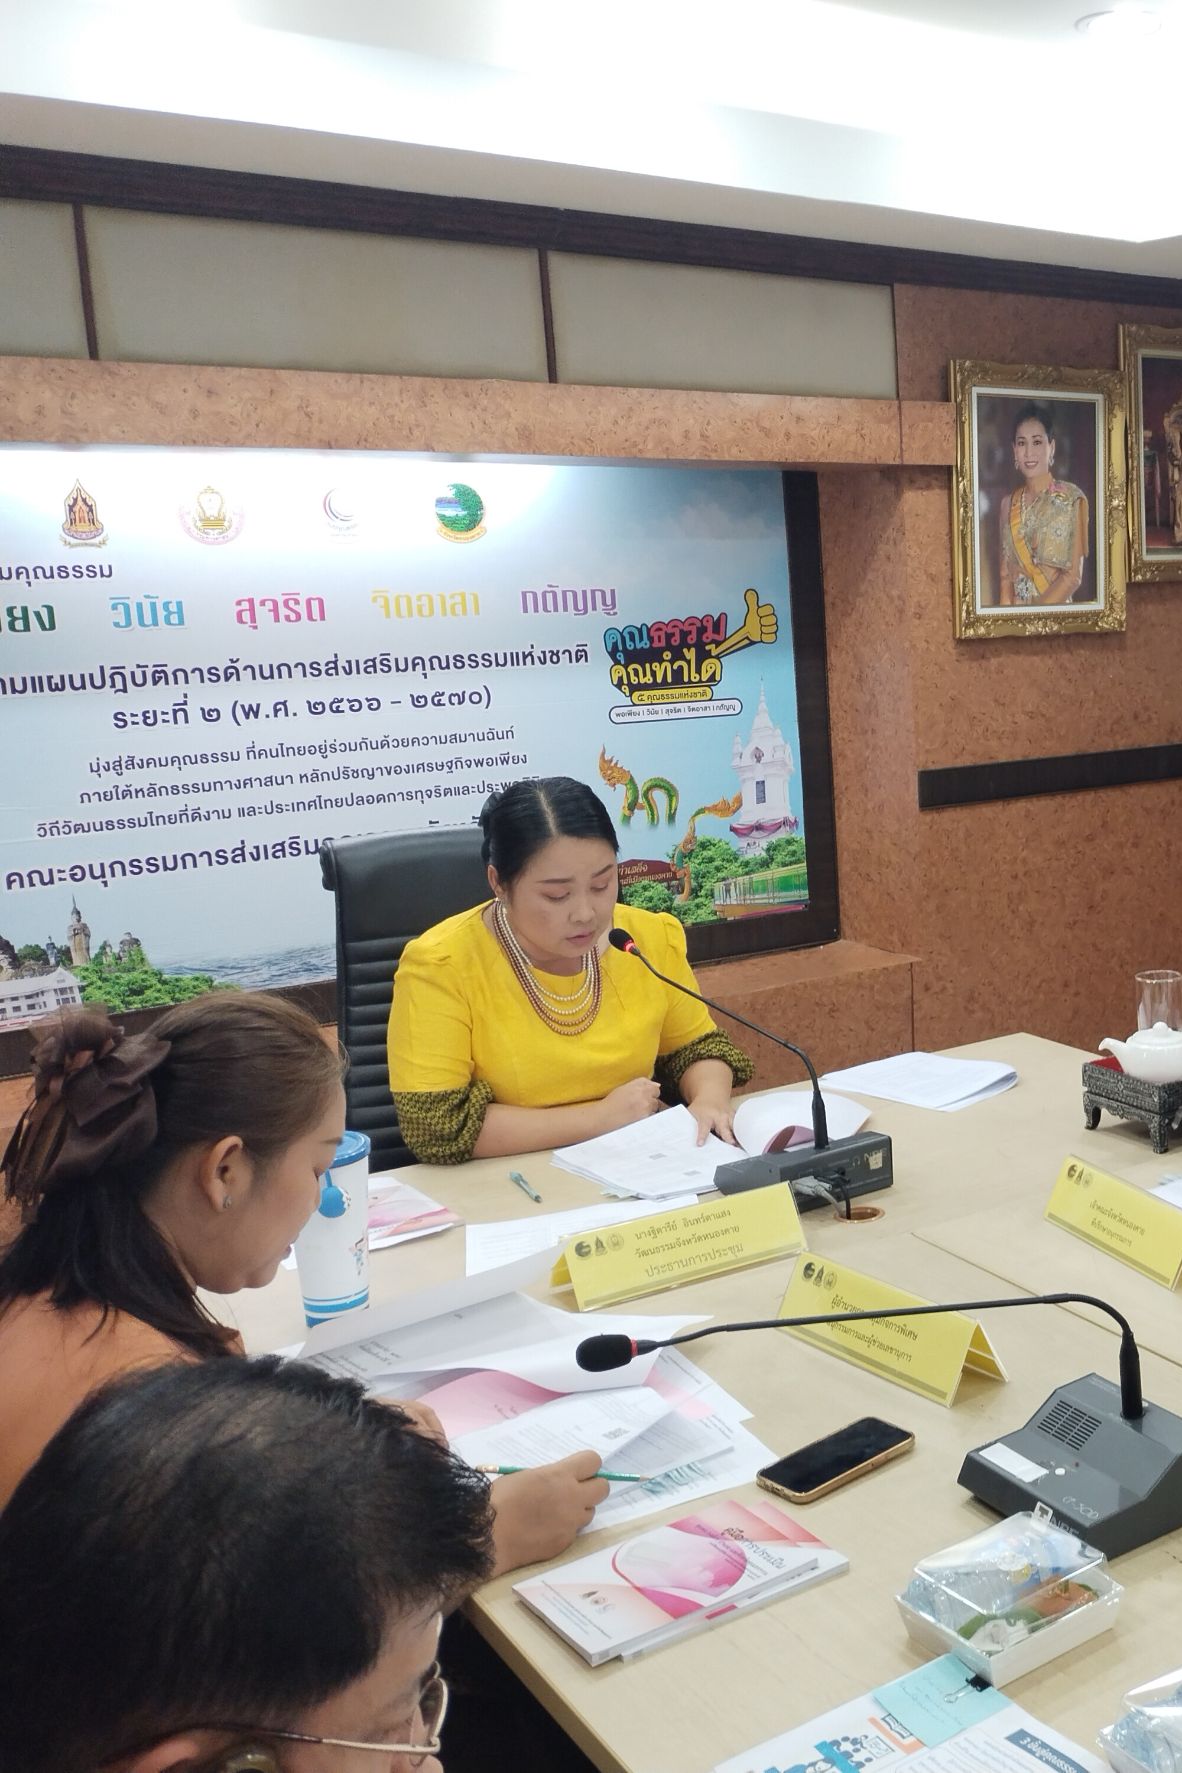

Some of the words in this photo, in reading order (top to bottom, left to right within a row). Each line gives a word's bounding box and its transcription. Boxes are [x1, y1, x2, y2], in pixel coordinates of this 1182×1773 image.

[0, 603, 57, 633] ยง
[109, 594, 187, 630] วินัย
[235, 592, 327, 630] สุจริต
[371, 589, 481, 620] จิตอาสา
[521, 583, 618, 616] กตัญญู
[604, 612, 728, 664] คุณธรรม
[610, 643, 722, 697] คุณทำได้
[112, 693, 190, 729] ระยะที่
[200, 705, 221, 725] ๒
[231, 697, 298, 727] (พ.ศ.
[306, 694, 382, 715] ๒๕๖๖
[410, 685, 492, 709] ๒๕๗๐)
[88, 749, 241, 778] มุ่งสู่สังคมคุณธรรม
[246, 725, 515, 761] ที่คนไทยอยู่ร่วมกันด้วยความสมานฉันท์
[78, 773, 295, 804] ภายใต้หลักธรรมทางศาสนา
[299, 752, 528, 784] หลักปรัชญาของเศรษฐกิจพอเพียง
[36, 803, 232, 838] วิถีวัฒนธรรมไทยที่ดีงาม
[634, 1223, 741, 1259] วัฒนธรรมจังหวัดหนองคาย
[644, 1241, 744, 1278] ประธานการประชุม
